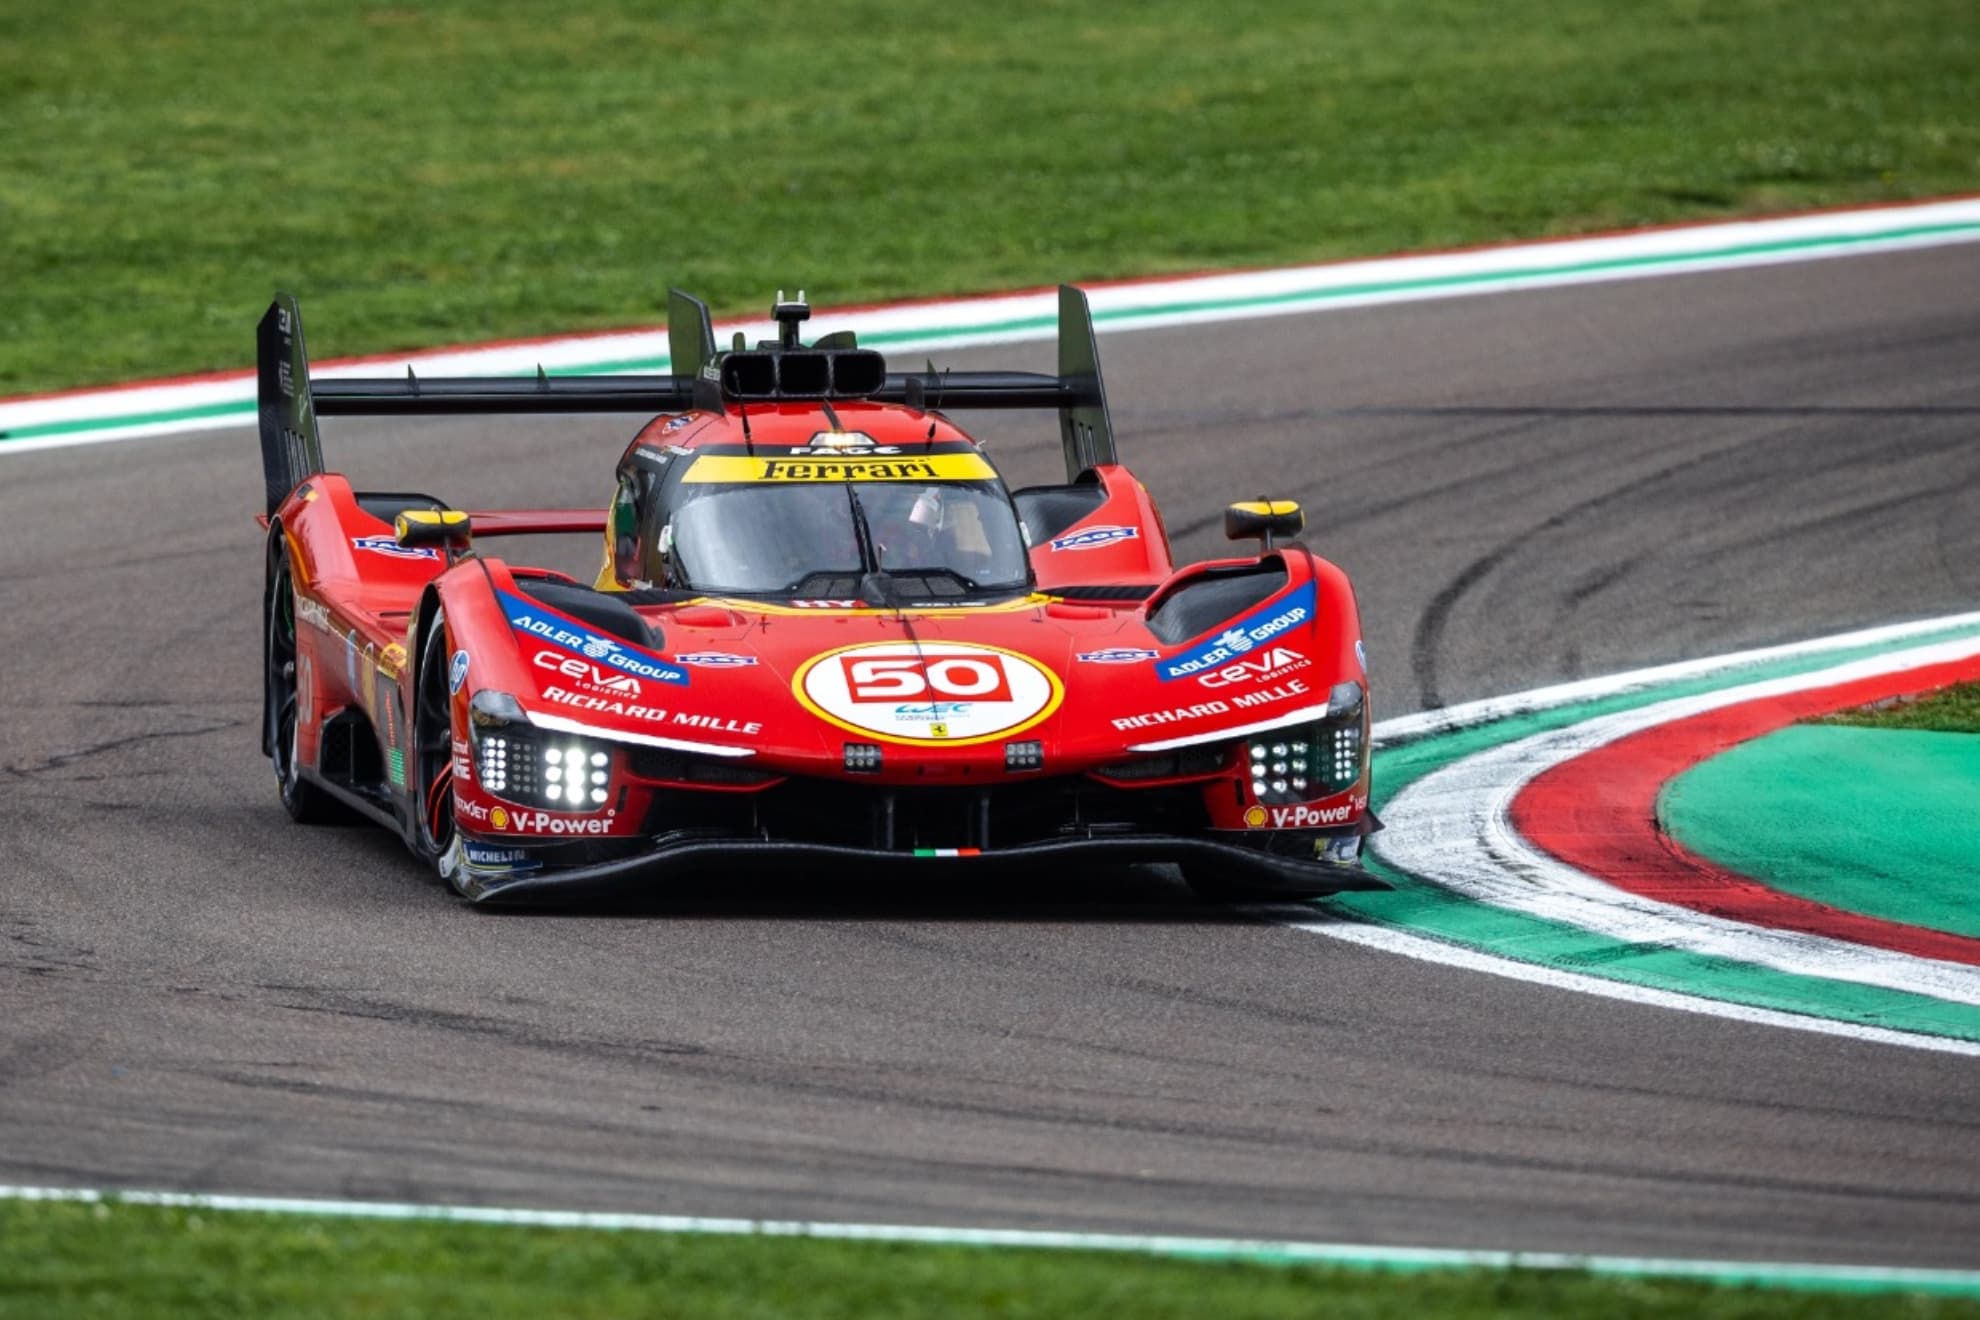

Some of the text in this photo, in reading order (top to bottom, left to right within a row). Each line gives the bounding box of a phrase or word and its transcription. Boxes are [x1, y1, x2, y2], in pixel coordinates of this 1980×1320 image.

[763, 457, 940, 479] Ferrari
[513, 615, 681, 681] ADLER GROUP
[1168, 607, 1307, 677] ADLER GROUP
[851, 659, 1000, 697] 50
[1255, 659, 1312, 683] LOGISTICS
[575, 680, 640, 699] LOGISTICS
[541, 686, 763, 735] RICHARD MILLE
[1111, 678, 1310, 731] RICHARD MILLE
[511, 812, 613, 834] V-Power
[1271, 805, 1351, 828] V-Power
[470, 849, 525, 862] MICHELIN
